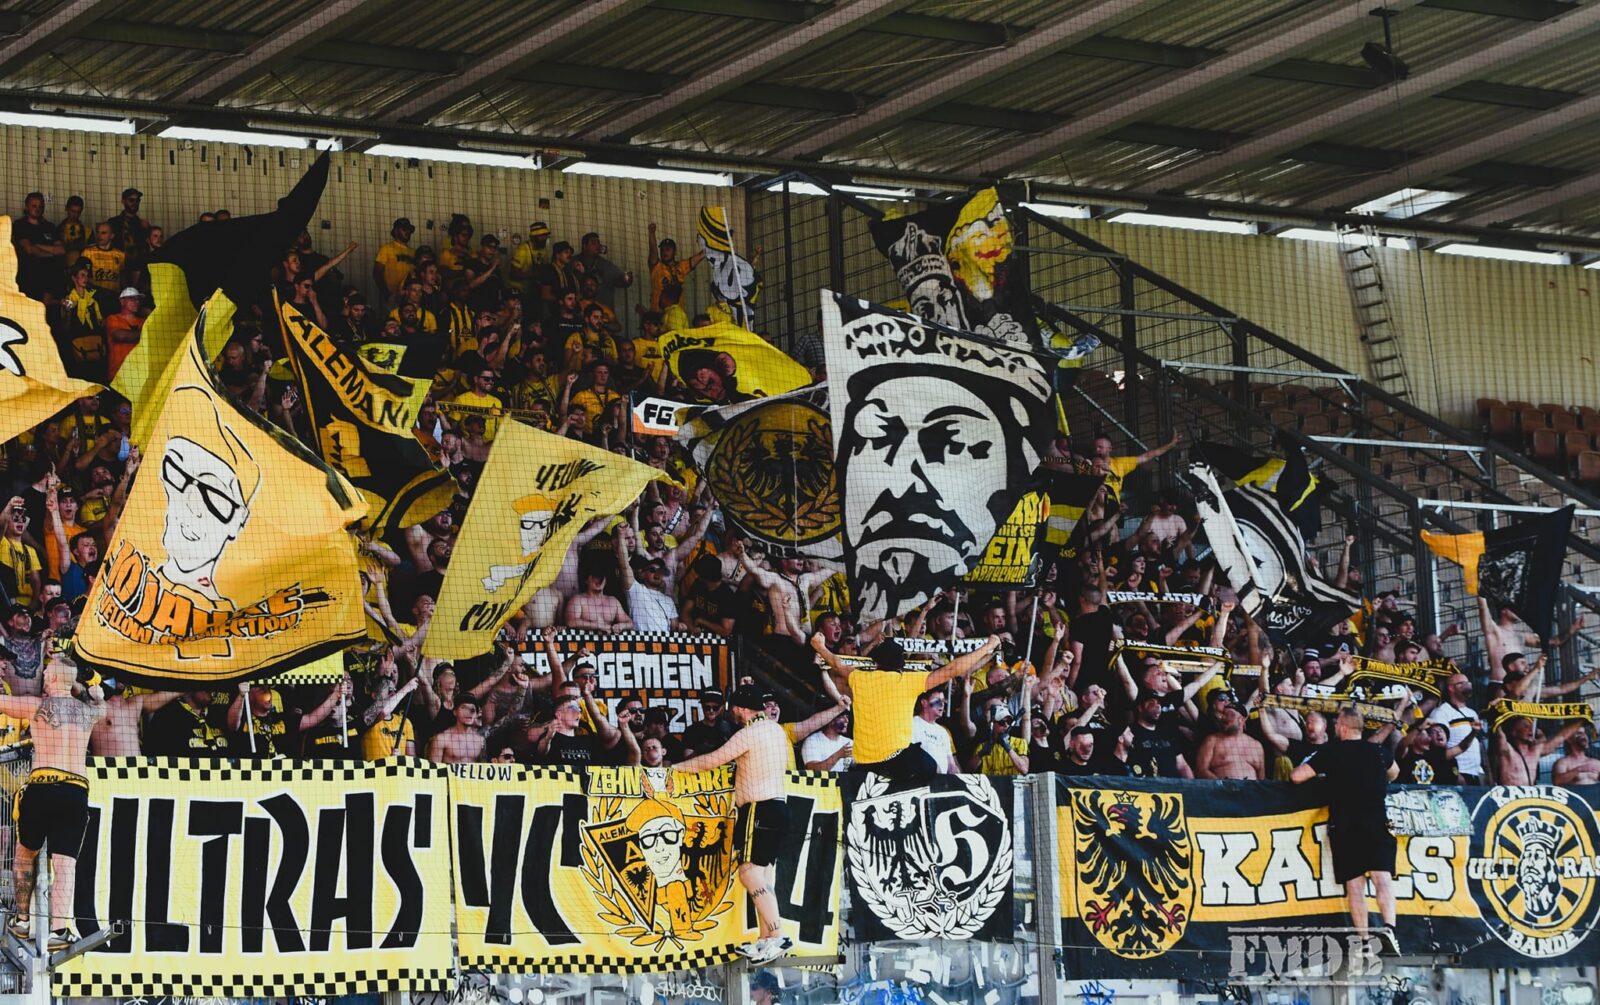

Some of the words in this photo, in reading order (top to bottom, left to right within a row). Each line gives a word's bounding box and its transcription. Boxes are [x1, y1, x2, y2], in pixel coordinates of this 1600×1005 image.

[449, 763, 512, 781] YELLOW
[587, 766, 642, 796] ZEHN
[672, 765, 735, 798] JAHRE
[74, 792, 433, 954] ULTRAS
[1195, 821, 1456, 906] KAS
[1507, 927, 1581, 956] BANDE
